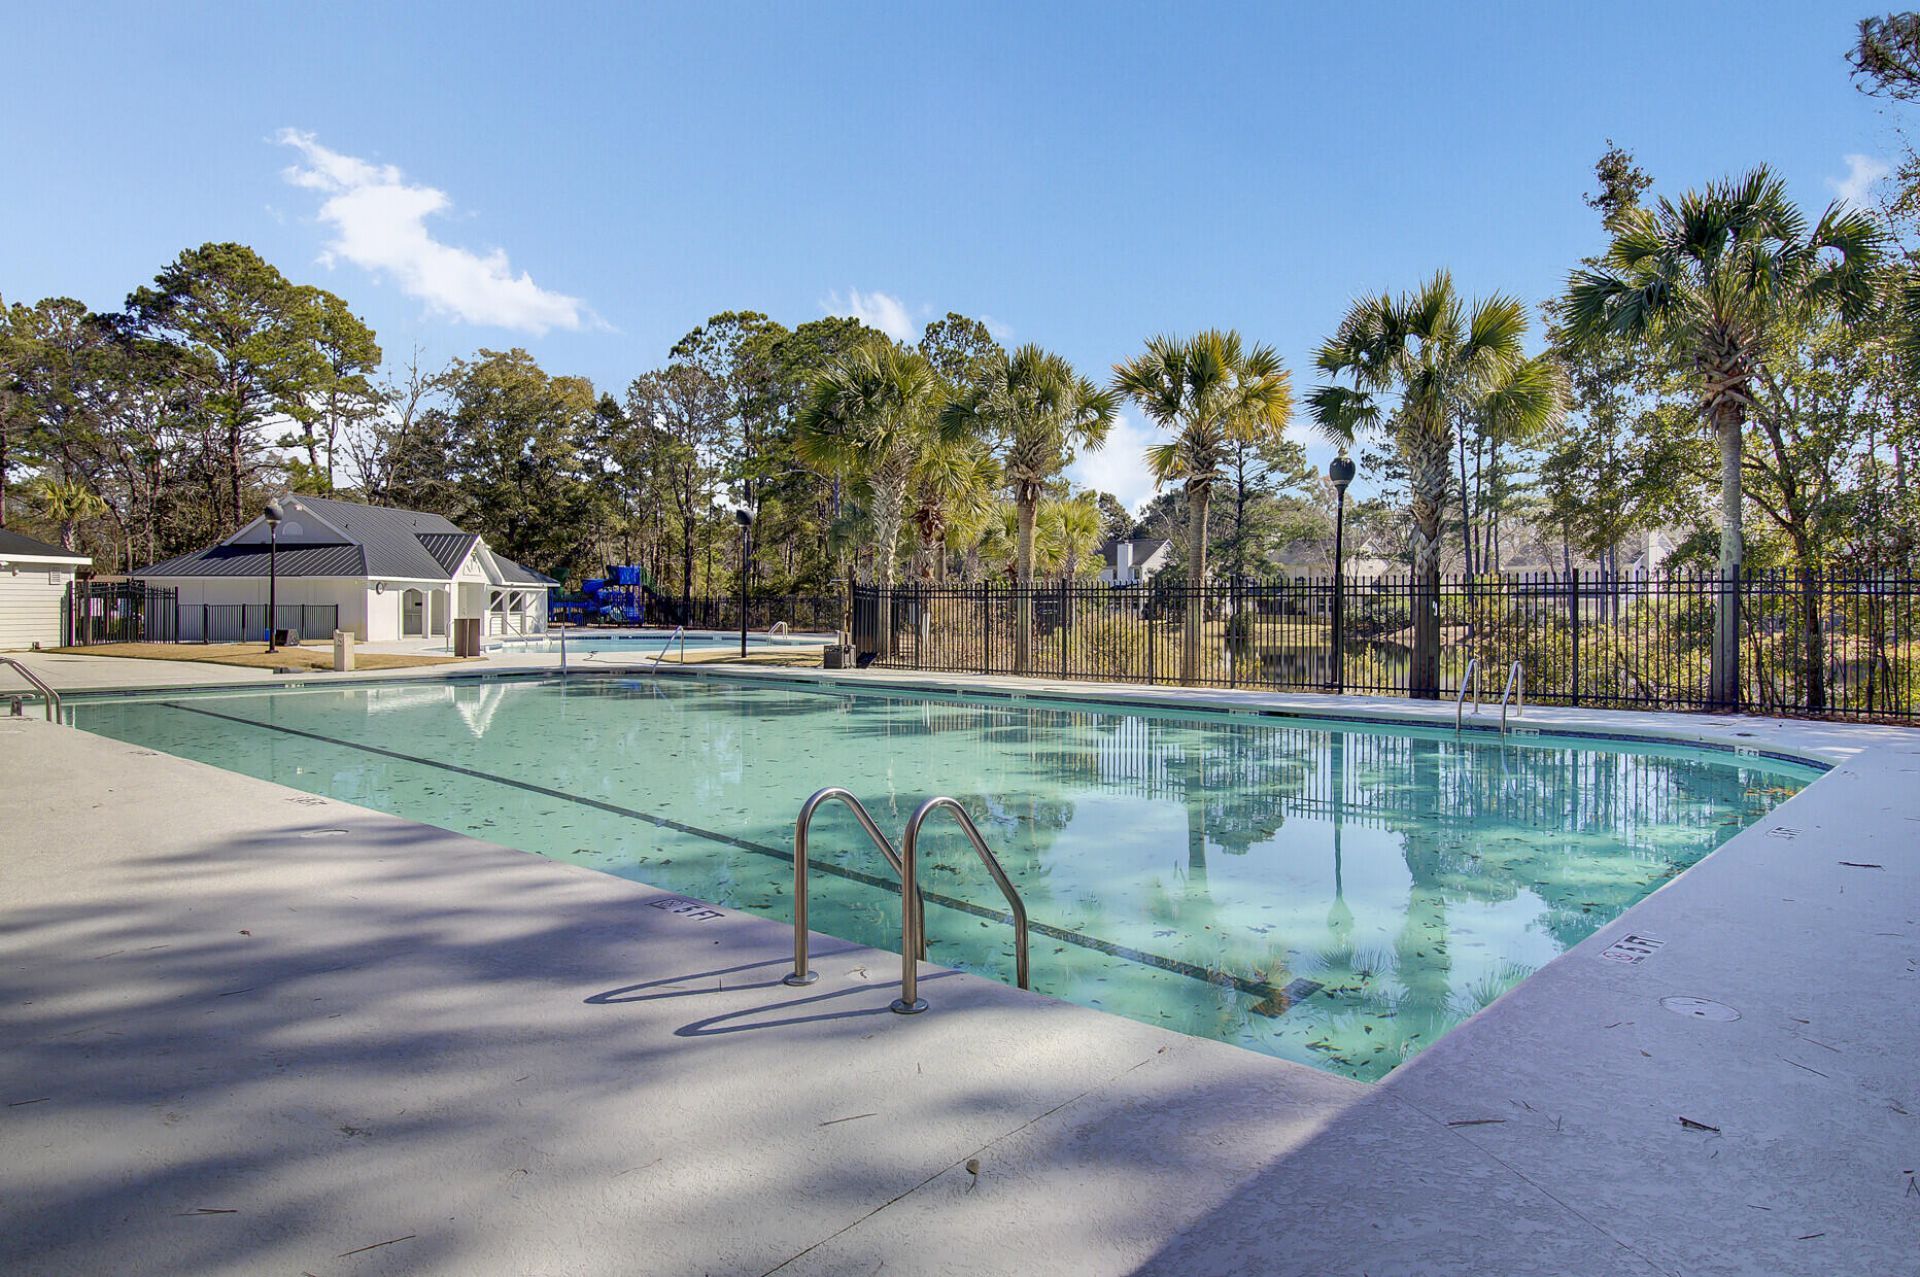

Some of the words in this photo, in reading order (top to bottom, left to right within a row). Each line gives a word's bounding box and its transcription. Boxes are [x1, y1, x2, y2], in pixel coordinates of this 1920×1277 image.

[686, 909, 726, 921] FT
[1624, 935, 1665, 949] FT
[1614, 944, 1652, 954] 5
